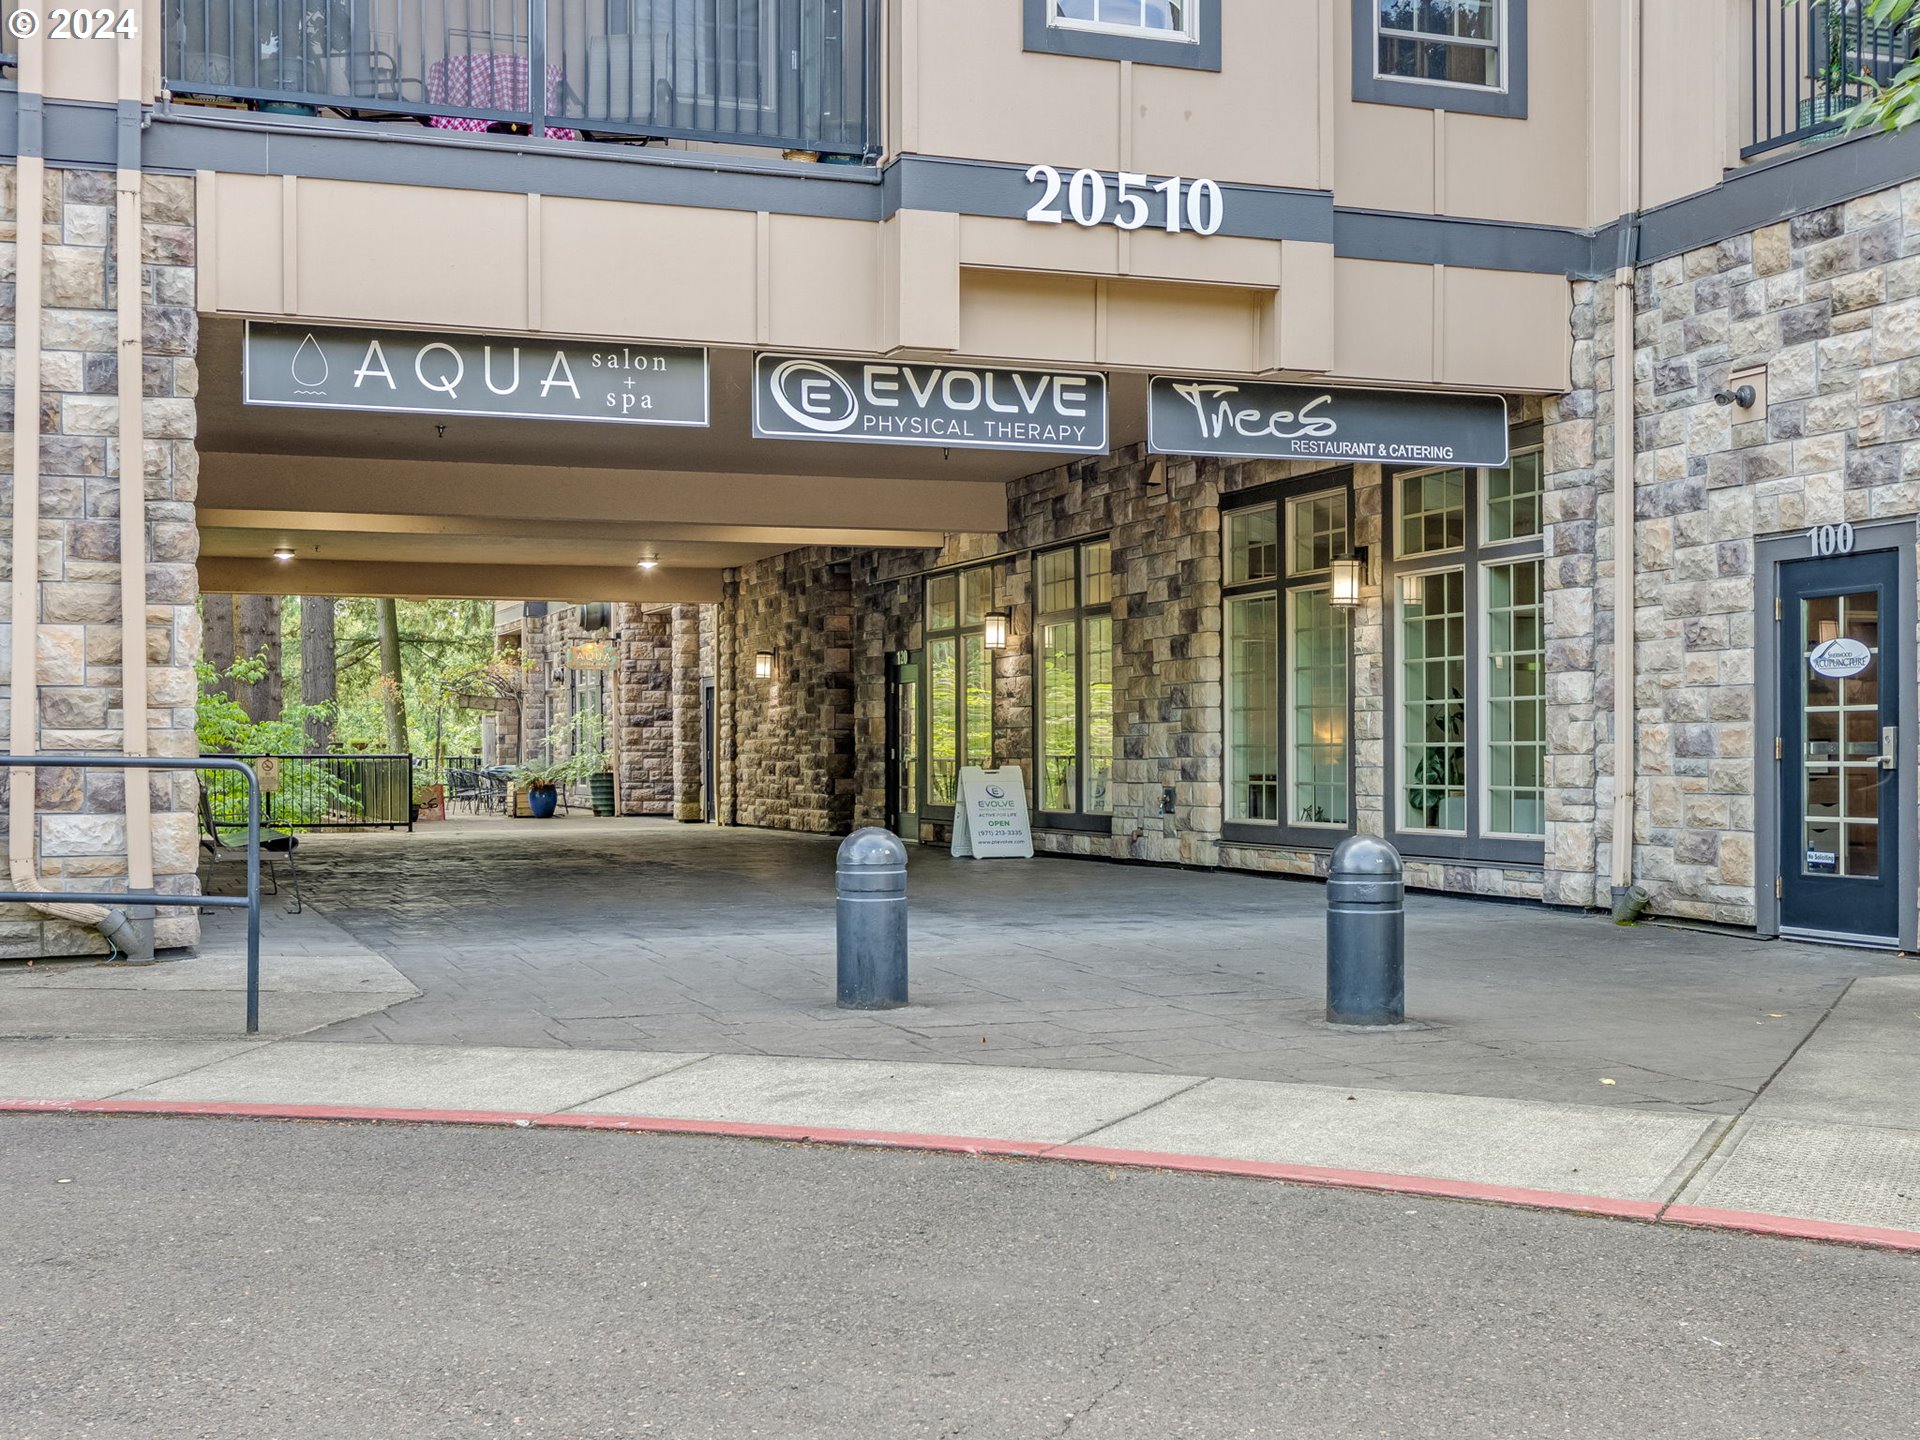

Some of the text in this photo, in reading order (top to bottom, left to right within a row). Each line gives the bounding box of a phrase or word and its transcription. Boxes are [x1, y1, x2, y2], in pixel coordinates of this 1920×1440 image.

[1025, 165, 1224, 236] 20510
[353, 340, 581, 400] AQUA
[591, 348, 667, 372] salon
[606, 392, 654, 414] spa
[801, 378, 831, 414] E
[863, 365, 1087, 417] EVOLVE
[1172, 383, 1338, 439] Trees
[863, 415, 1086, 442] PHYSICAL THERAPY
[1291, 440, 1454, 460] RESTAURANT & CATERING
[1806, 522, 1854, 557] 100
[576, 652, 611, 662] AQUA
[896, 650, 908, 665] 120
[1815, 655, 1869, 668] ACUPUNCTURE
